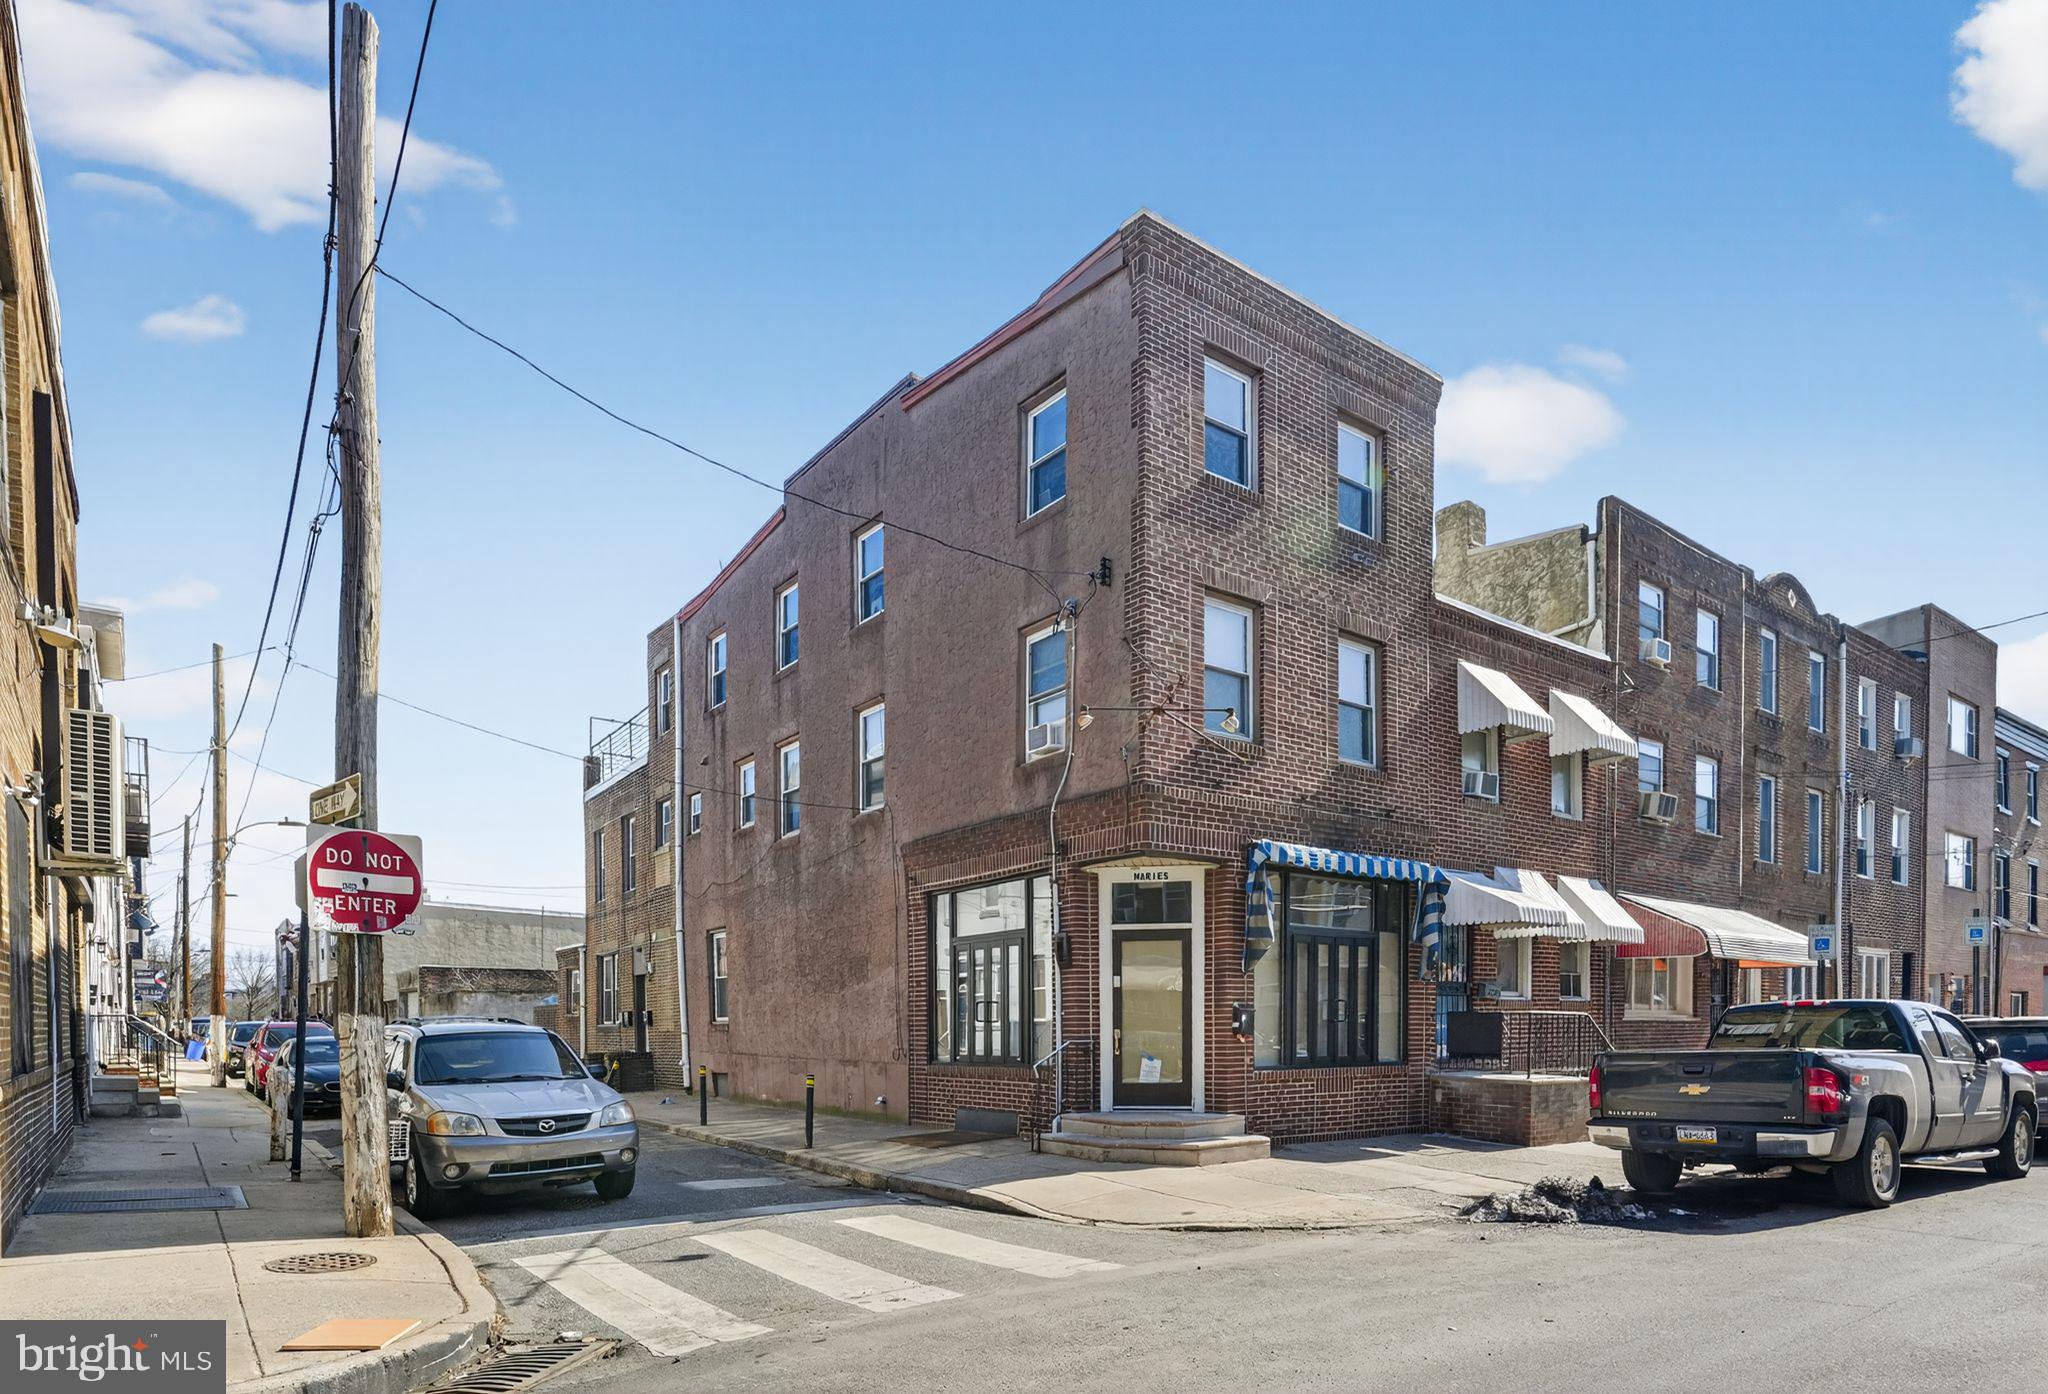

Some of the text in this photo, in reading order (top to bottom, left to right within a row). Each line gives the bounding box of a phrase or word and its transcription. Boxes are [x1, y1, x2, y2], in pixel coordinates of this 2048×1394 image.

[315, 791, 345, 818] ONE WAY
[326, 847, 404, 871] DO NOT
[1133, 871, 1169, 881] MARIES
[335, 894, 396, 915] ENTER
